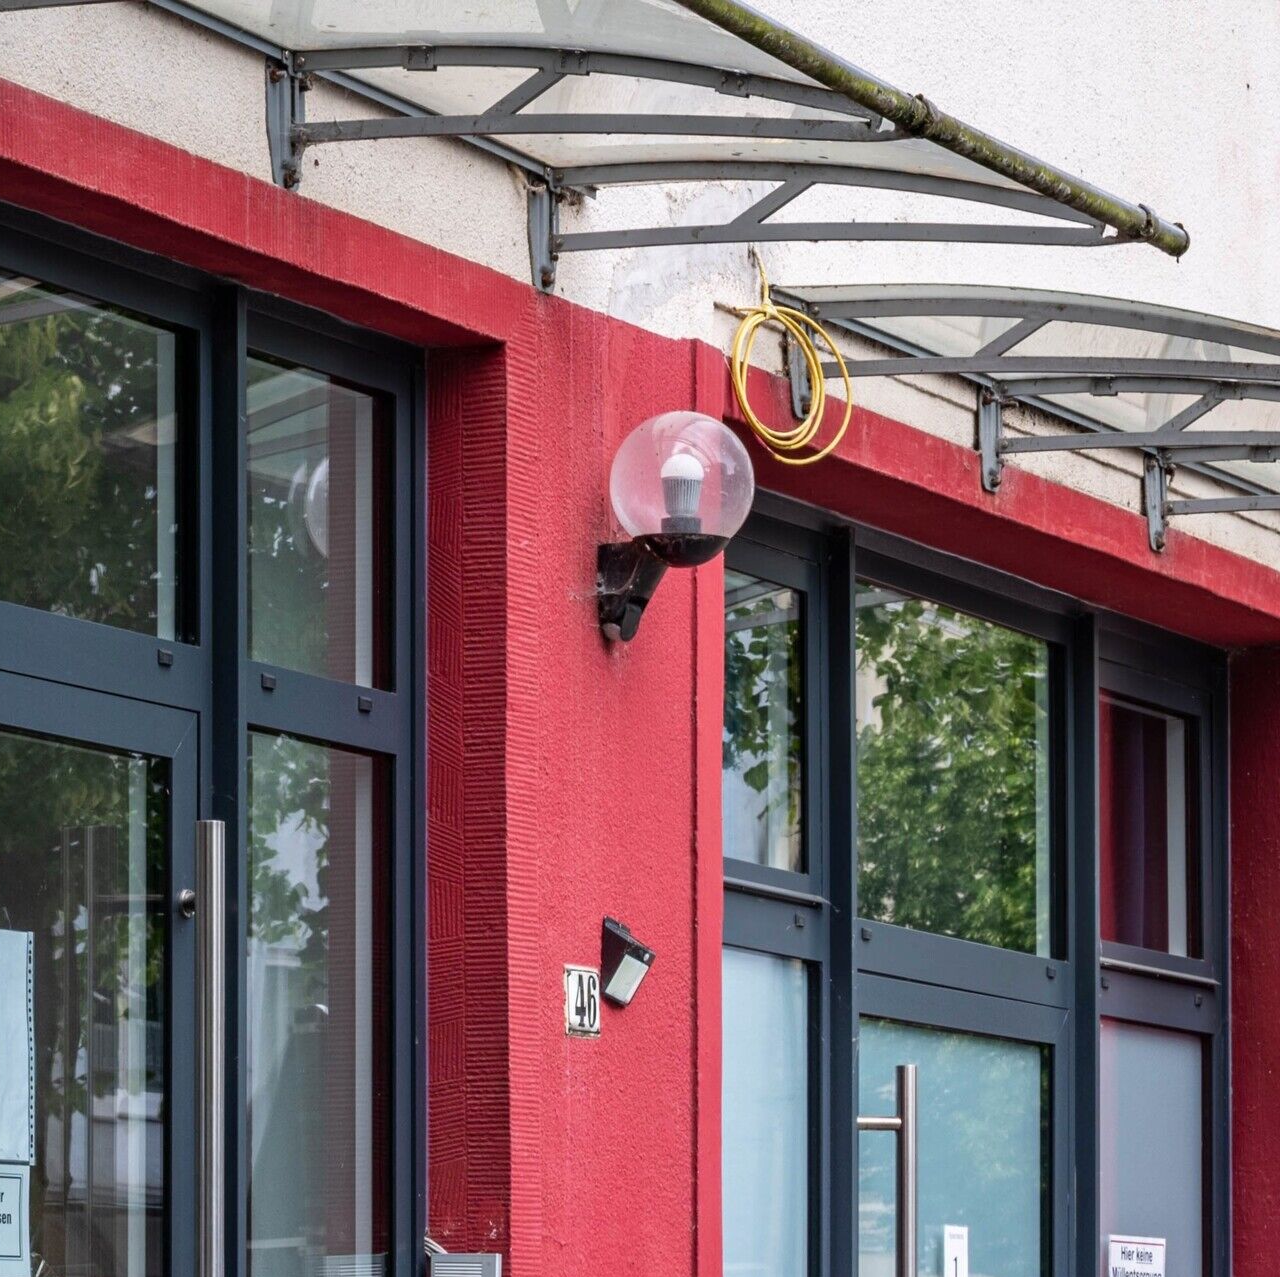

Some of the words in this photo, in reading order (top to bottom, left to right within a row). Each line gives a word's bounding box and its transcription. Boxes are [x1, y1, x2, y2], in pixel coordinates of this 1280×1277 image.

[575, 974, 597, 1028] 46
[1121, 1246, 1135, 1261] Hier
[1136, 1247, 1153, 1262] keine
